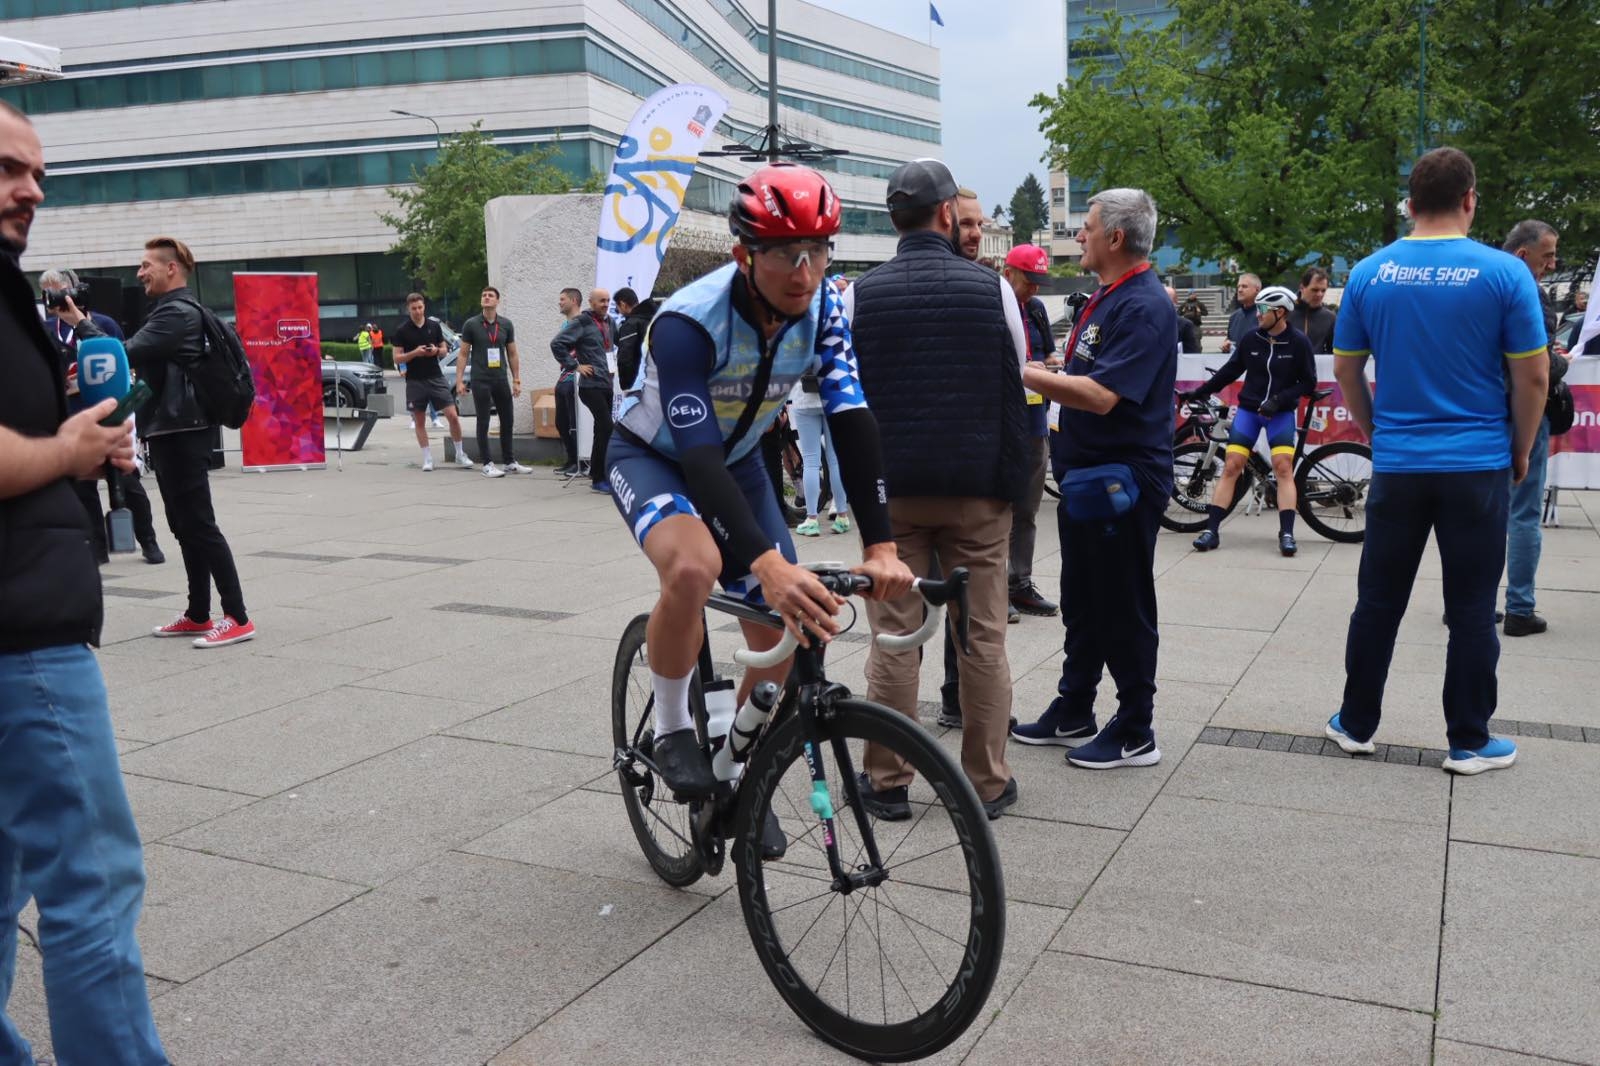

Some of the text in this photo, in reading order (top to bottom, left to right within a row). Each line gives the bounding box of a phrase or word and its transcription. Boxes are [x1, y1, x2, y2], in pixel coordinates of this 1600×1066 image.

[1397, 266, 1434, 280] BIKE
[1435, 266, 1480, 282] SHOP
[609, 465, 637, 515] HELLAS
